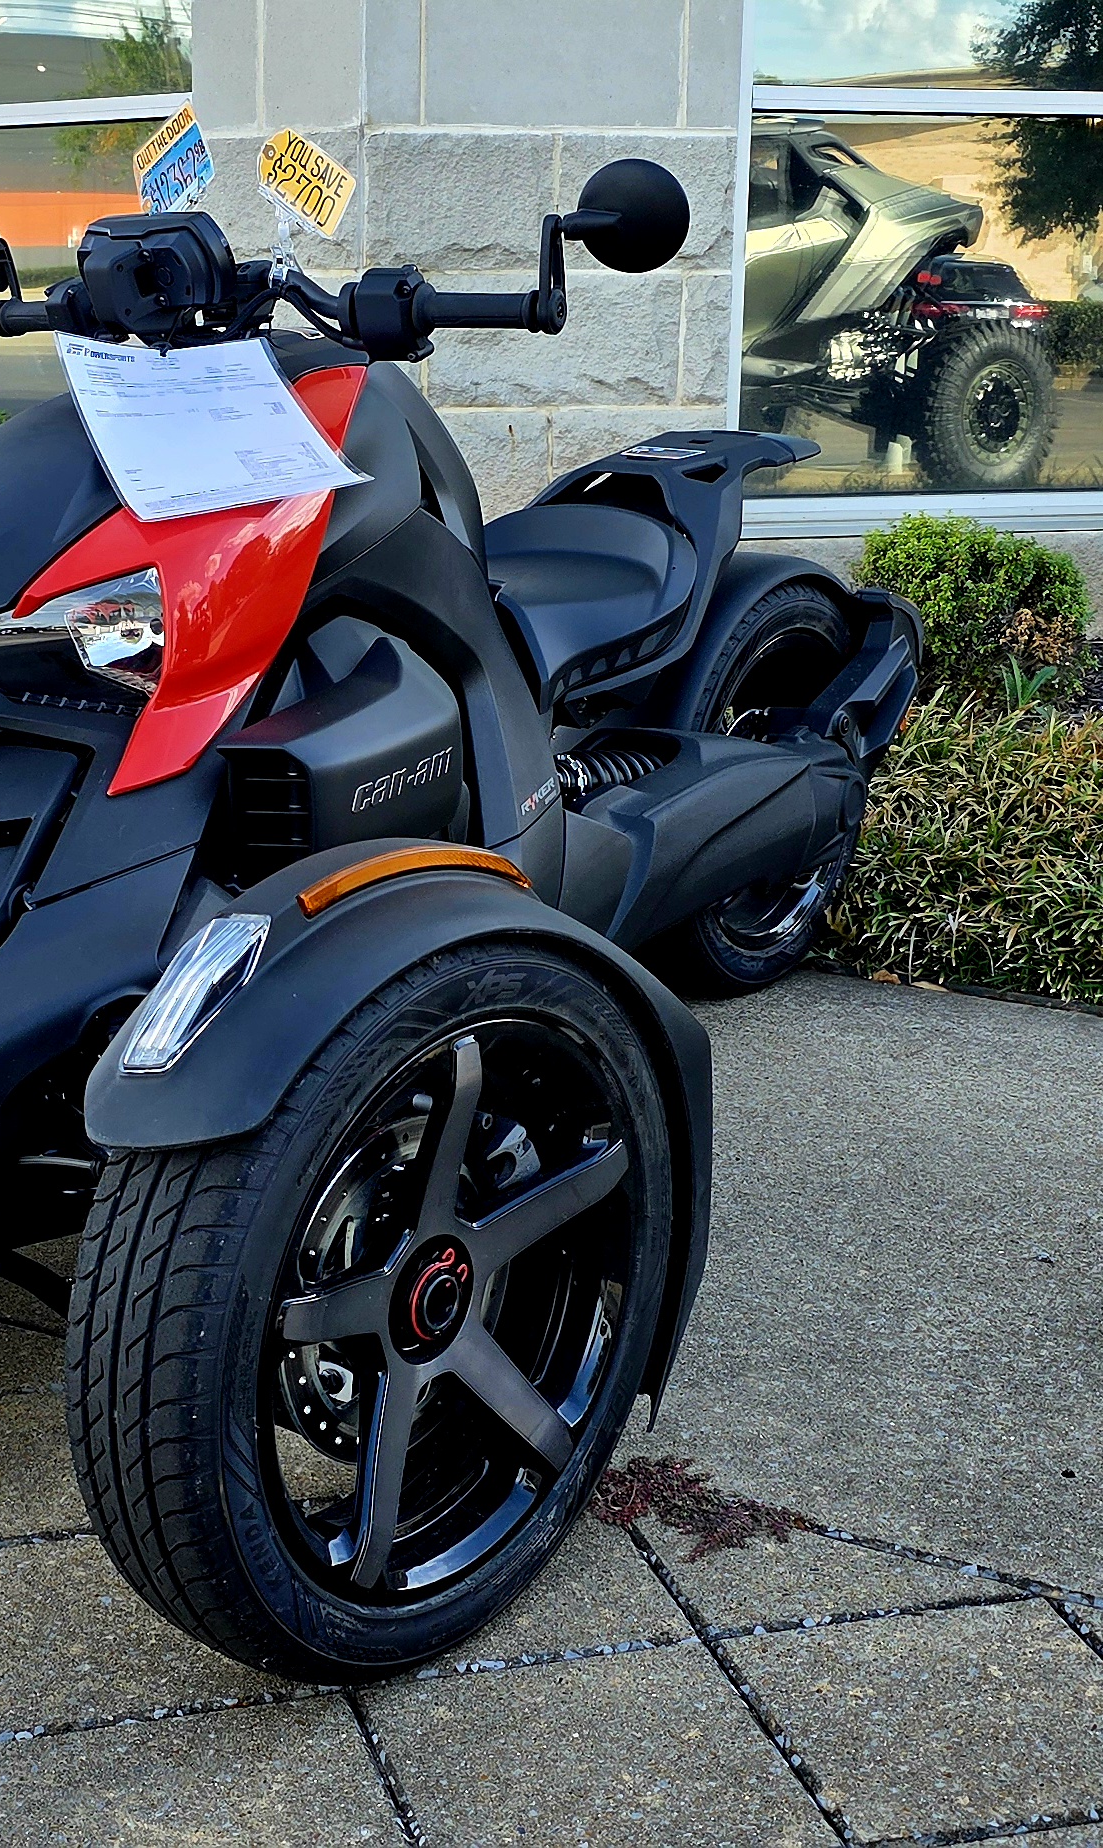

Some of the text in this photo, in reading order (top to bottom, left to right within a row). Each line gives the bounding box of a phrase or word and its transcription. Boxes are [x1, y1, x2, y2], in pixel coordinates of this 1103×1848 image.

[136, 143, 153, 171] OUT
[150, 130, 169, 155] THE
[166, 108, 194, 140] DOOR
[285, 131, 348, 198] YOU SAVE
[459, 969, 527, 1011] XPS
